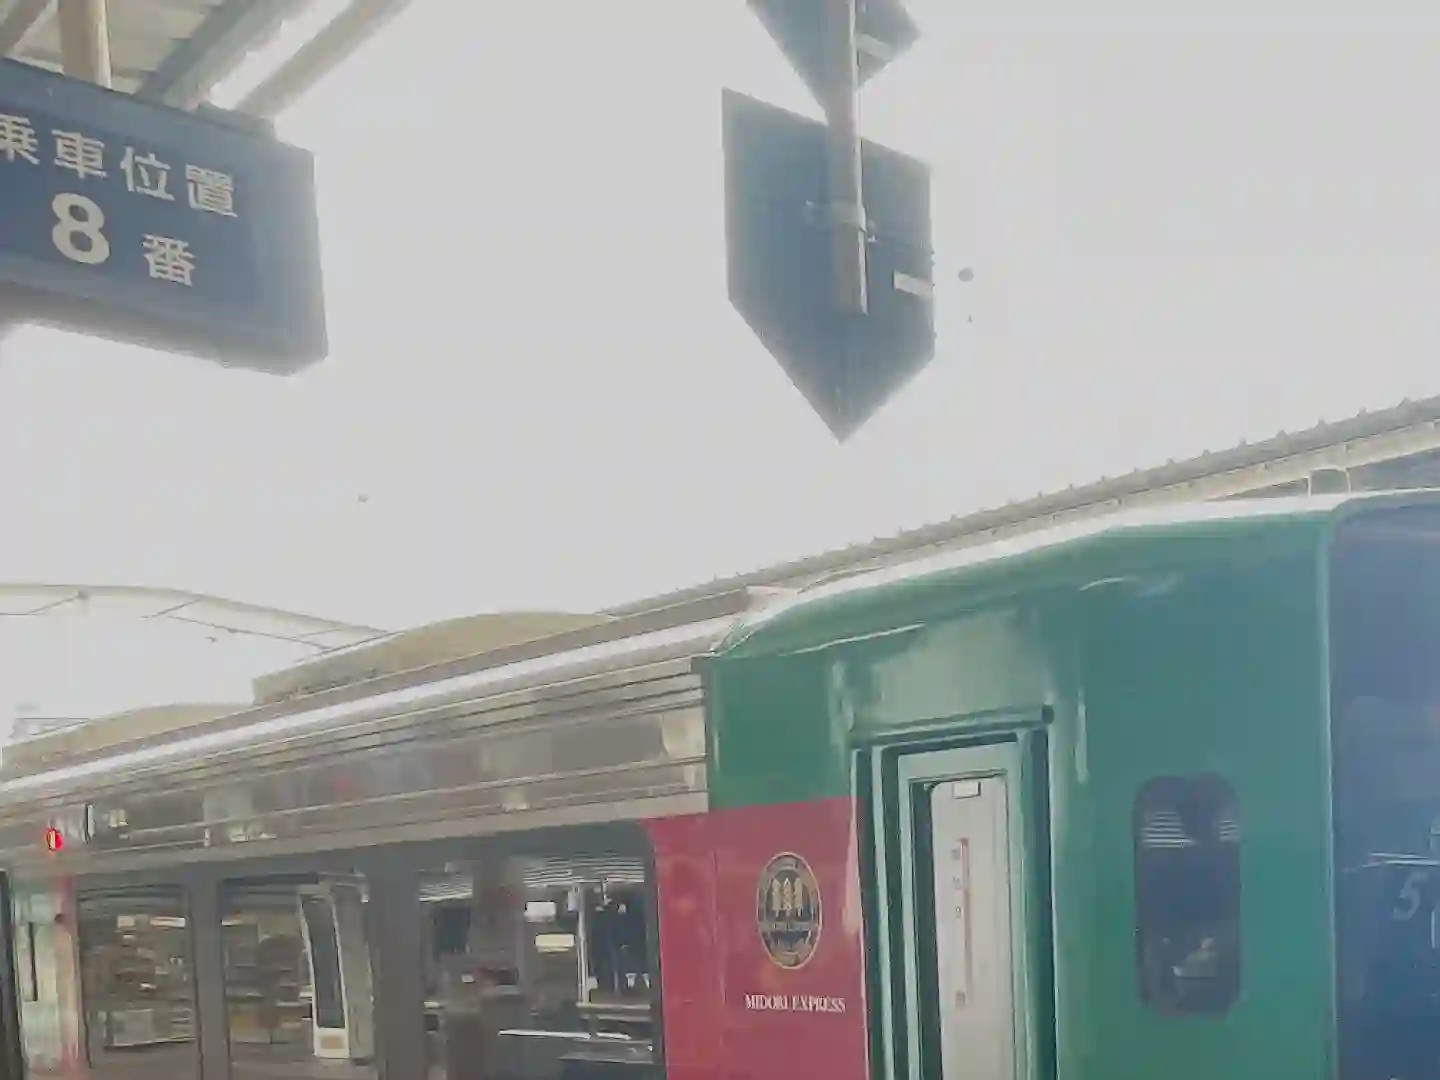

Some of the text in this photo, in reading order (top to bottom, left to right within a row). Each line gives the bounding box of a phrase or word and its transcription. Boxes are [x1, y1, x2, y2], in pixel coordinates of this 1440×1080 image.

[52, 192, 110, 265] 8
[745, 993, 847, 1014] MIDORI EXPRESS
